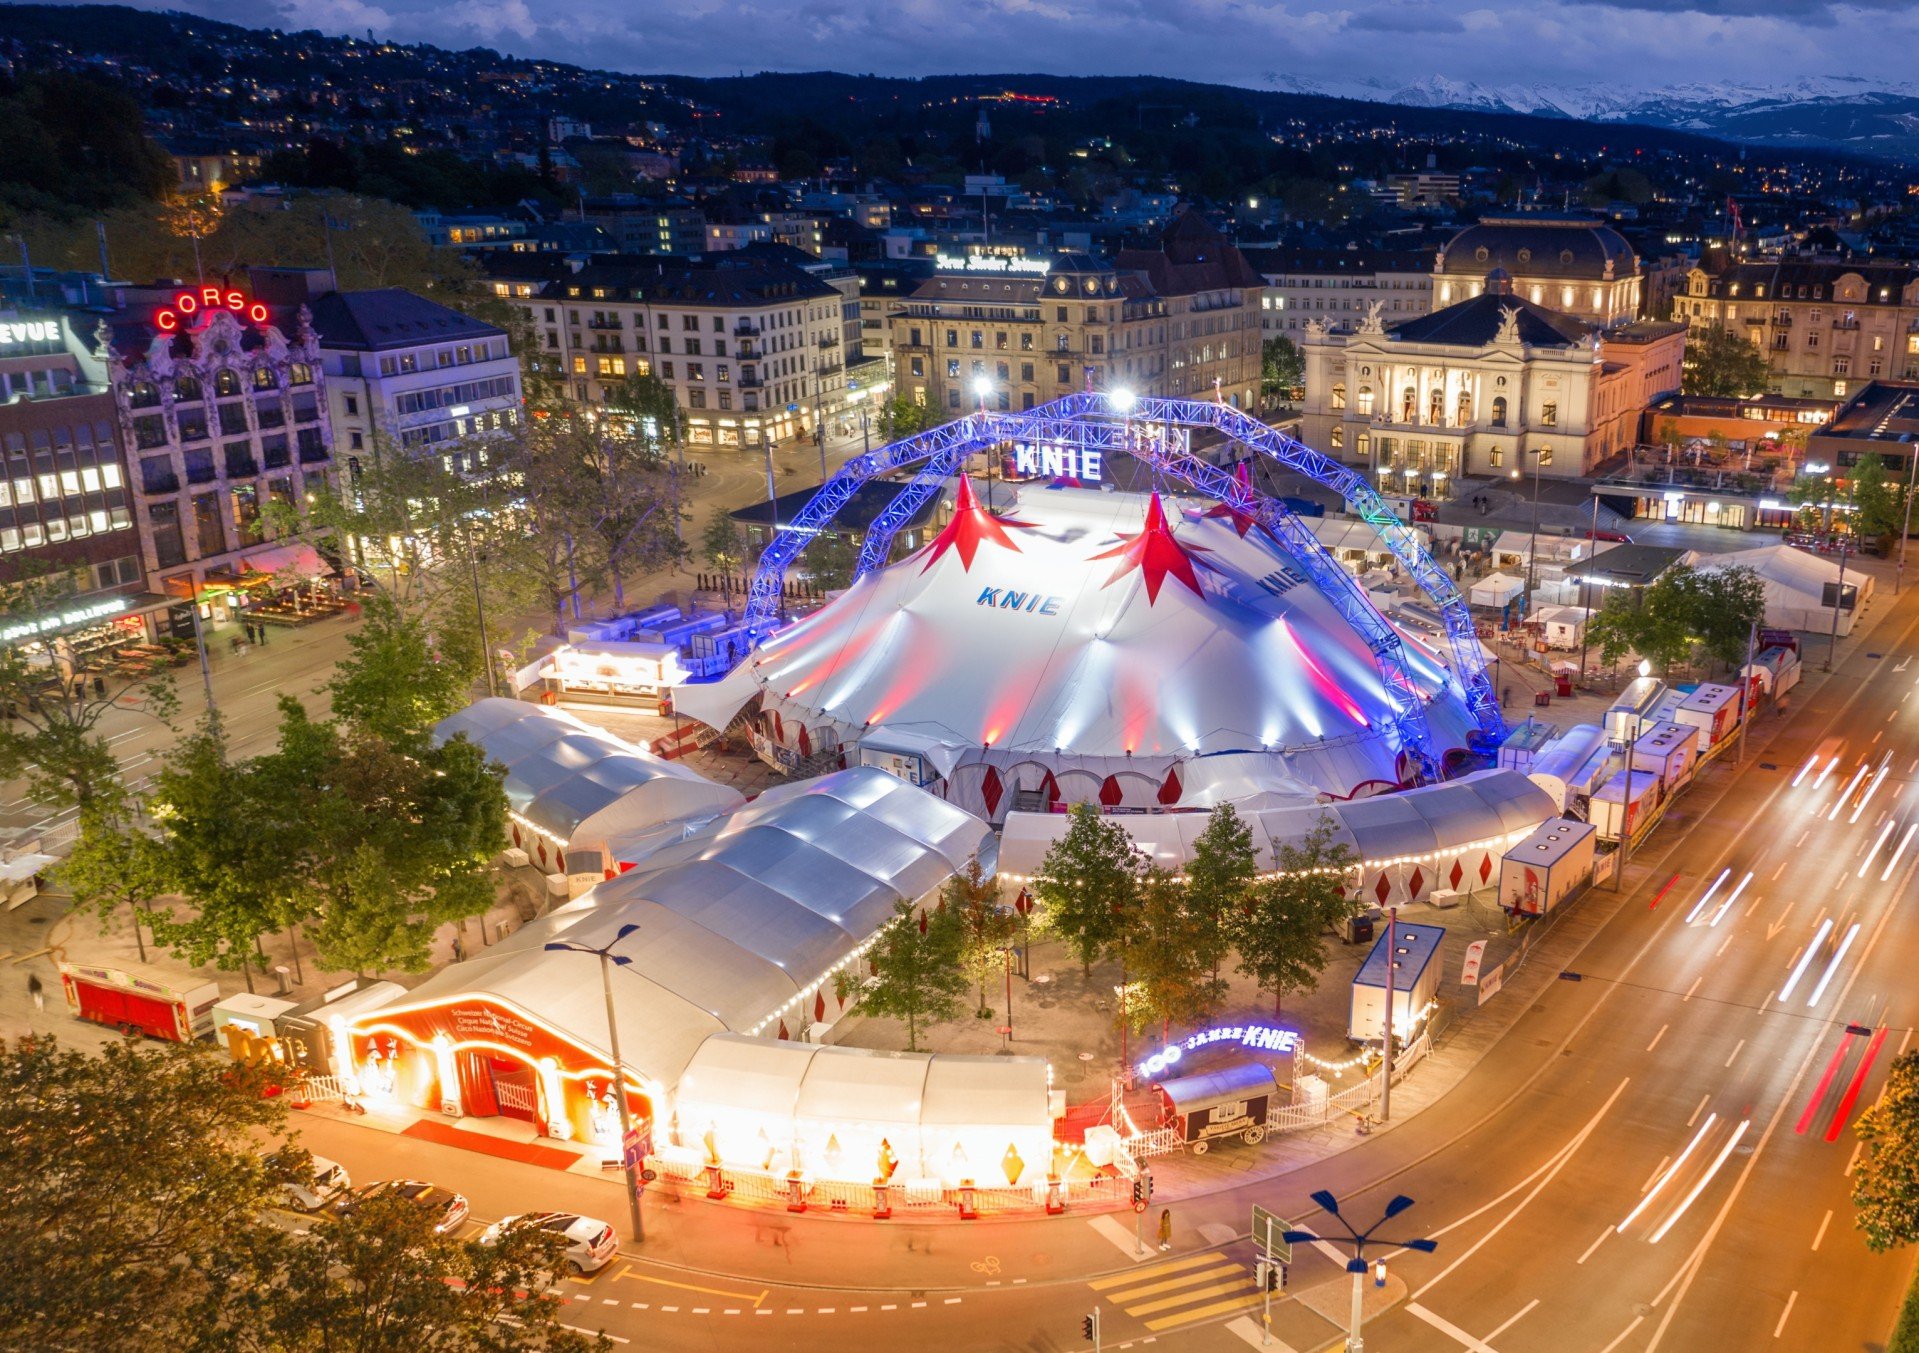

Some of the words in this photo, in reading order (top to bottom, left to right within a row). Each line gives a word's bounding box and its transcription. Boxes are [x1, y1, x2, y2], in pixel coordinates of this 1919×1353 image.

[158, 288, 267, 330] CORSO
[1015, 444, 1101, 481] KNIE
[1255, 567, 1309, 597] KNIE
[977, 586, 1066, 616] KNIE
[451, 1009, 482, 1017] Schweizer
[457, 1017, 479, 1026] Cirque
[508, 1025, 528, 1038] Suisse
[456, 1025, 473, 1033] Circo
[1139, 1045, 1181, 1078] 100
[1242, 1025, 1298, 1052] KNIE
